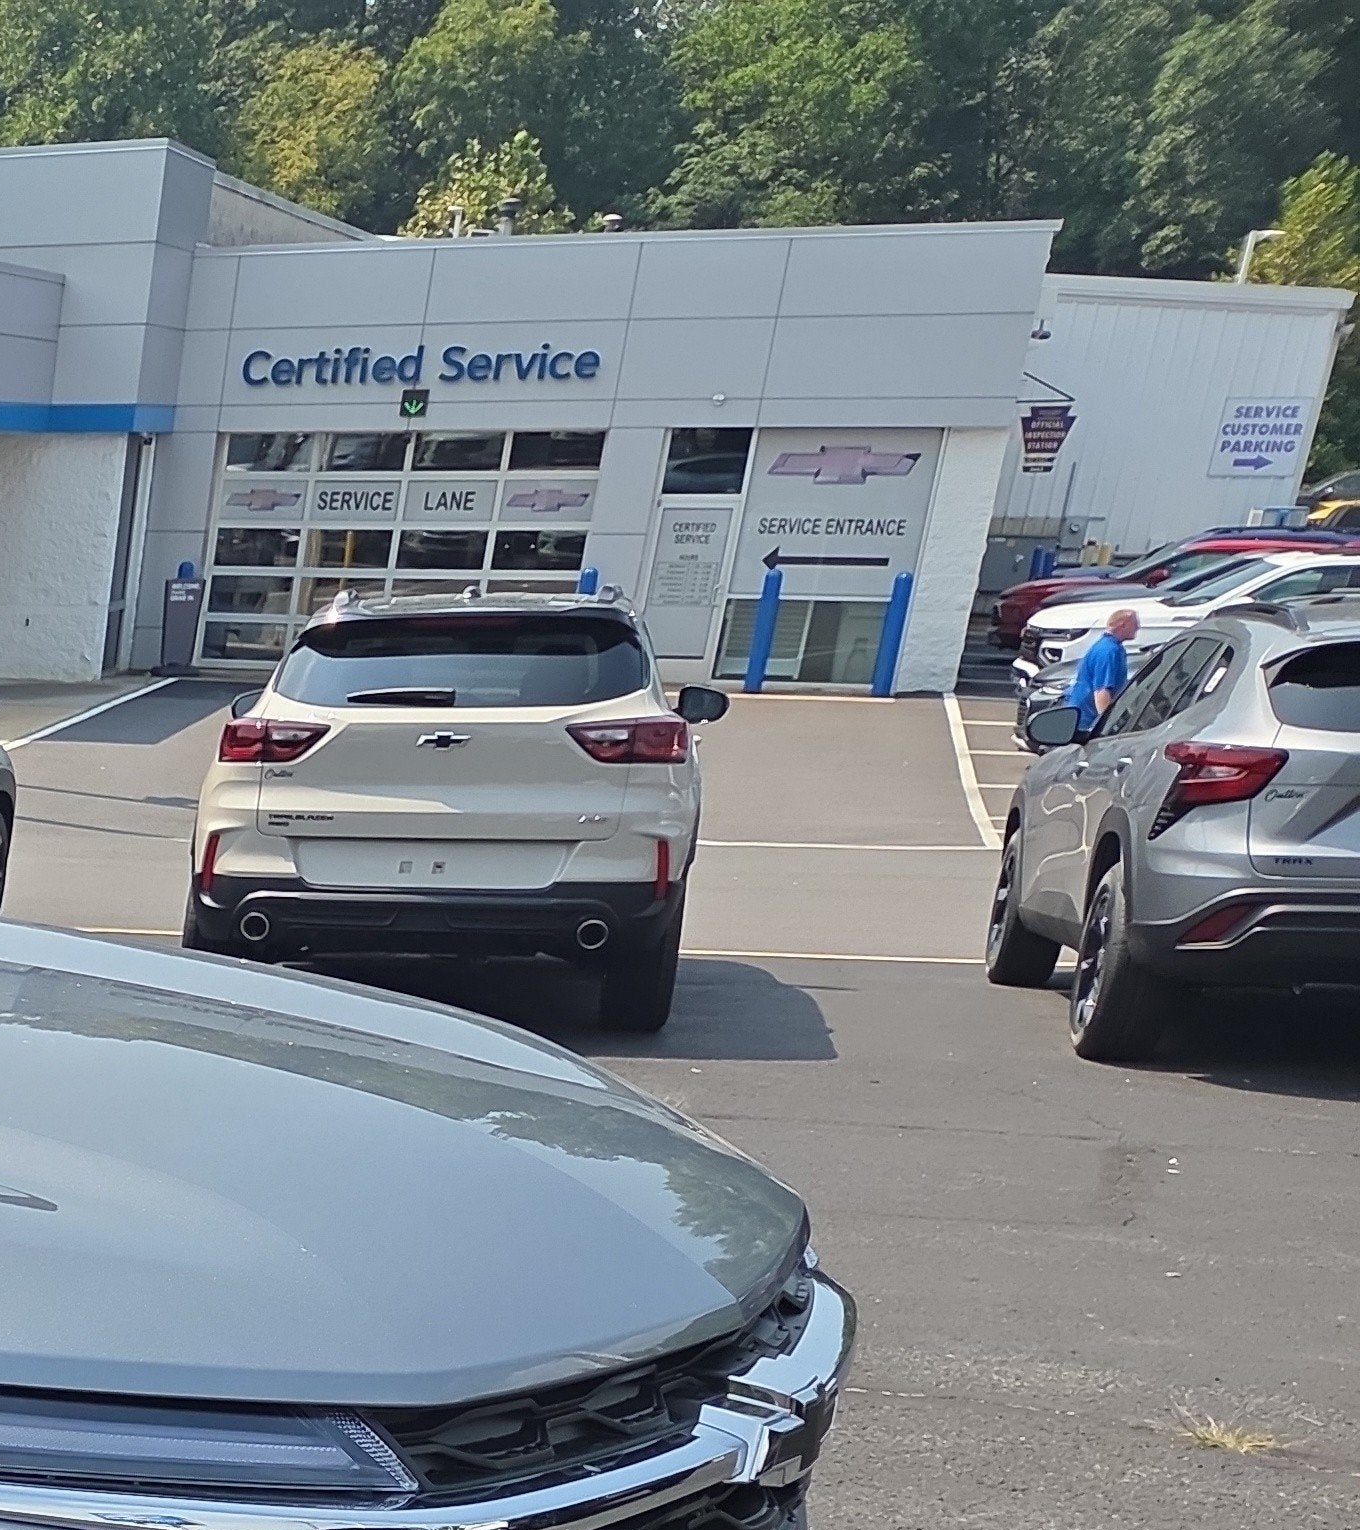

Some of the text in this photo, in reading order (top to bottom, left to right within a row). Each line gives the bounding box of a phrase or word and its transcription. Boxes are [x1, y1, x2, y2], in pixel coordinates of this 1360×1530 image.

[242, 343, 601, 387] Certified Service
[1234, 405, 1300, 418] SERVICE
[1222, 423, 1303, 436] CUSTOMER
[1220, 440, 1296, 453] PARKING
[317, 491, 477, 511] SERVICE LANE
[758, 517, 907, 536] SERVICE ENTRANCE
[674, 534, 710, 544] SERVICE
